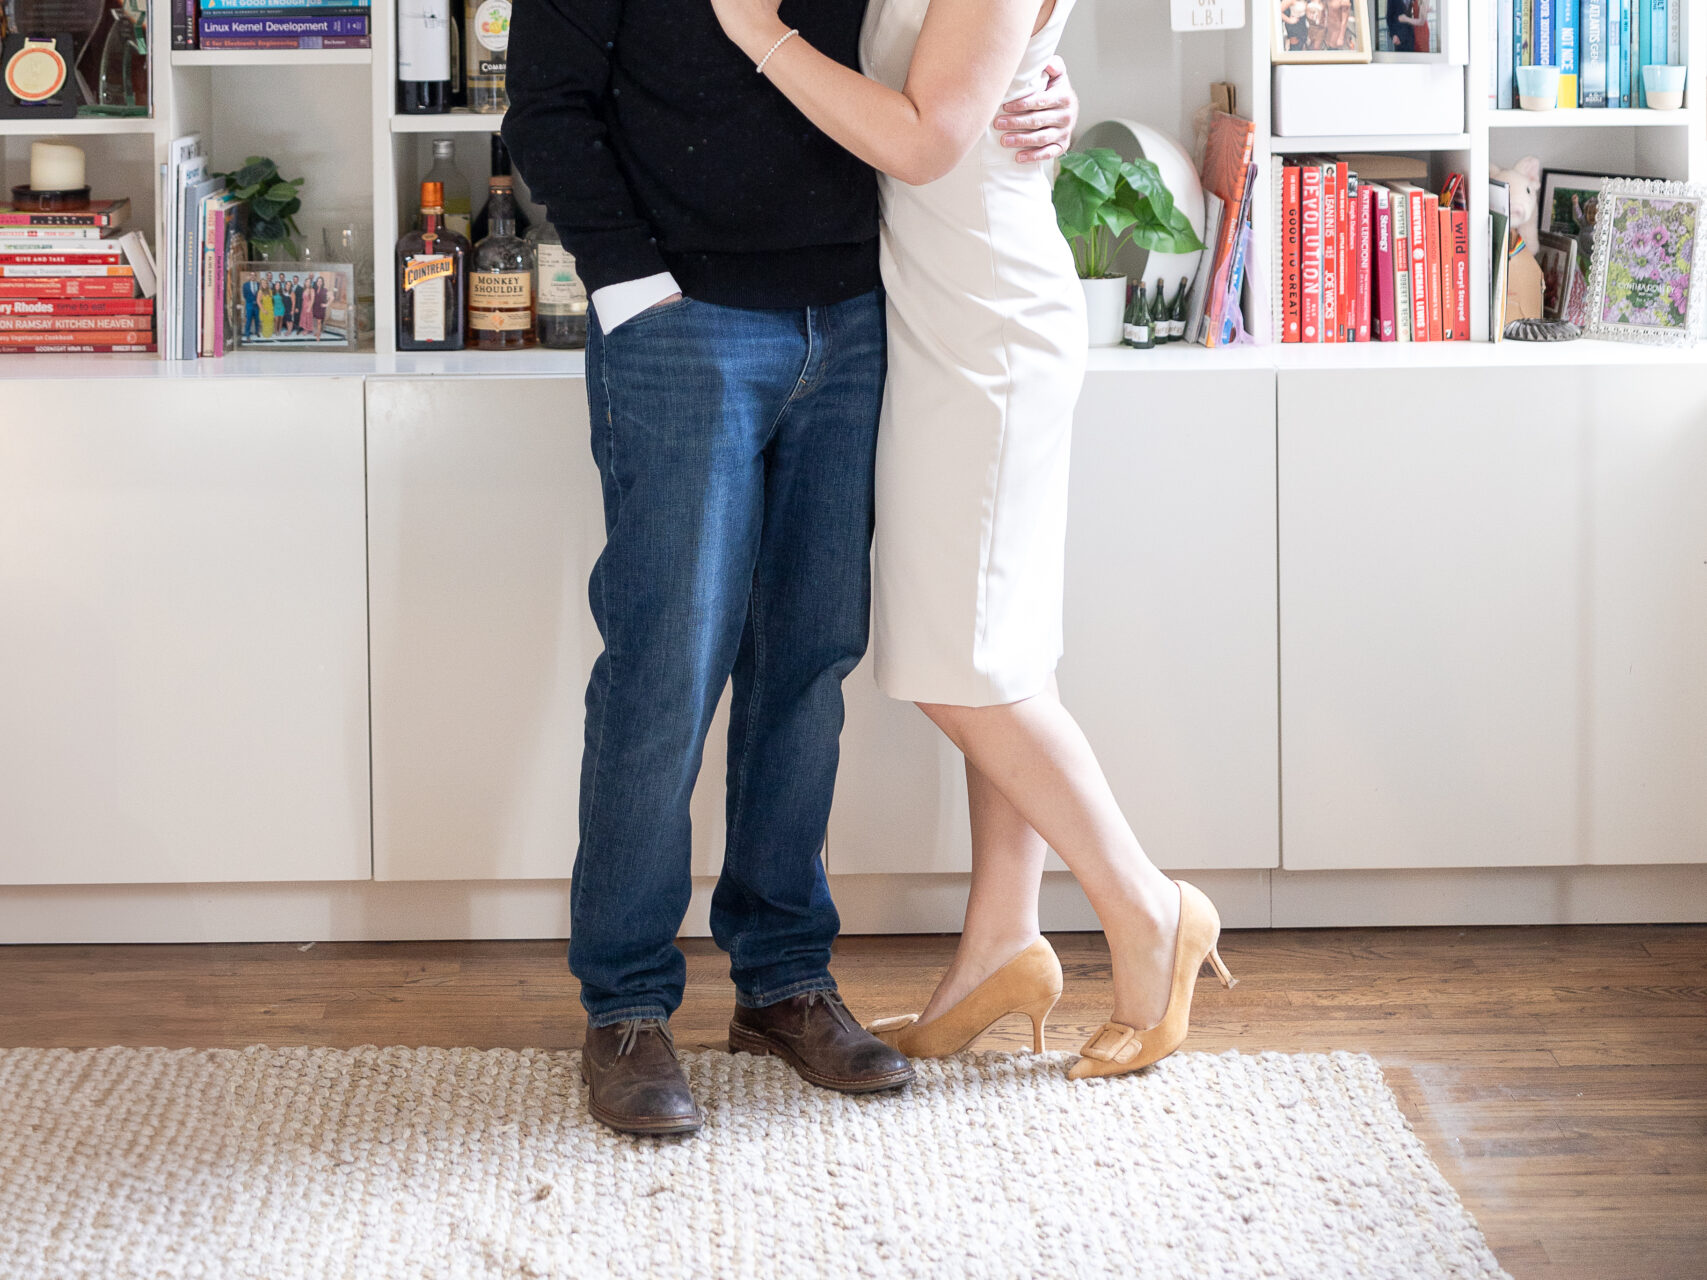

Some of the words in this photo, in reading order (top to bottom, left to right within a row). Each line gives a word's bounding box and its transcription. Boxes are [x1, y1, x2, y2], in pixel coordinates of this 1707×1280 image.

[221, 0, 236, 7] THE
[204, 22, 229, 32] Linux
[232, 22, 262, 32] Kernel
[266, 21, 328, 32] Development
[1561, 27, 1573, 46] NOT
[1589, 4, 1600, 43] ATLANTIS
[258, 40, 298, 48] Engineering
[1541, 18, 1550, 65] RUNNING
[1562, 48, 1574, 70] NICE
[1325, 194, 1335, 214] LEAN
[1361, 189, 1369, 224] PATRICK
[1289, 209, 1297, 244] GOOD
[1325, 214, 1335, 223] IN
[1397, 210, 1406, 236] SYSTEM
[1412, 196, 1422, 245] MONEYBALL
[1302, 172, 1320, 294] DEVOLUTION
[1379, 214, 1388, 252] Strategy
[1455, 222, 1466, 254] wild
[1289, 252, 1297, 267] TO
[1361, 226, 1369, 268] LENCIONI
[407, 261, 450, 285] COINTREAU
[478, 276, 520, 285] MONKEY
[1325, 270, 1335, 288] JOE
[1415, 262, 1424, 299] MICHAEL
[1456, 261, 1465, 288] Cheryl
[474, 285, 524, 293] SHOULDER
[1289, 274, 1297, 317] GREAT
[14, 302, 54, 312] Rhodes
[1326, 289, 1335, 319] WICKS
[1416, 301, 1425, 328] LEWIS
[1457, 290, 1465, 321] Strayed
[16, 320, 52, 328] RAMSAY
[55, 320, 94, 328] KITCHEN
[97, 320, 134, 328] HEAVEN
